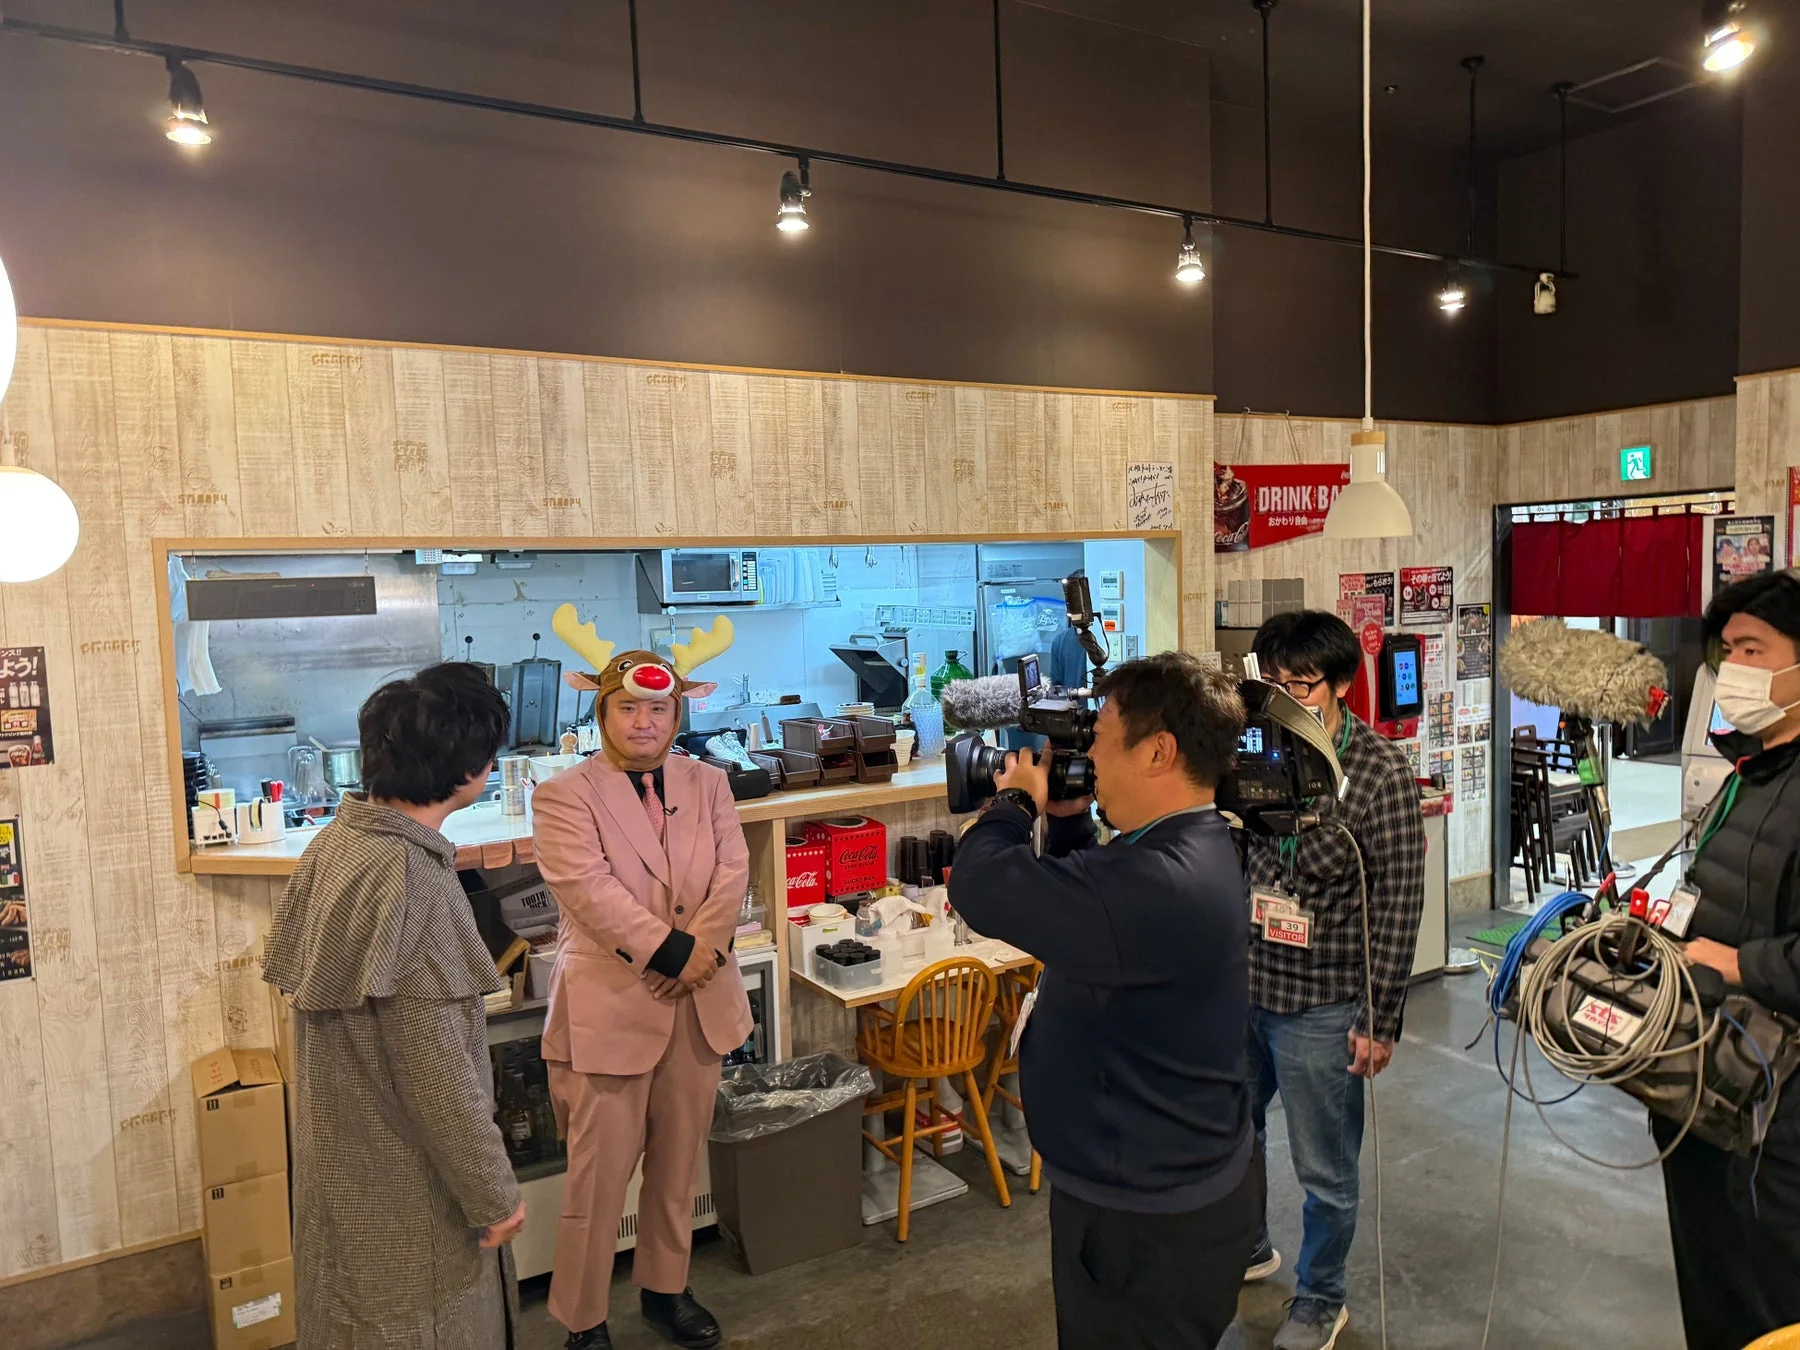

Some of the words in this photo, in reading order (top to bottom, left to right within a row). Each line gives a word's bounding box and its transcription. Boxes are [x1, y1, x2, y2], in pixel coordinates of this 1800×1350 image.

[1259, 485, 1313, 513] DRINK
[1318, 485, 1345, 511] BA
[786, 871, 819, 889] ca-Cola
[521, 890, 546, 908] TOOTH
[1270, 929, 1304, 942] VISITOR
[1286, 922, 1299, 931] 39
